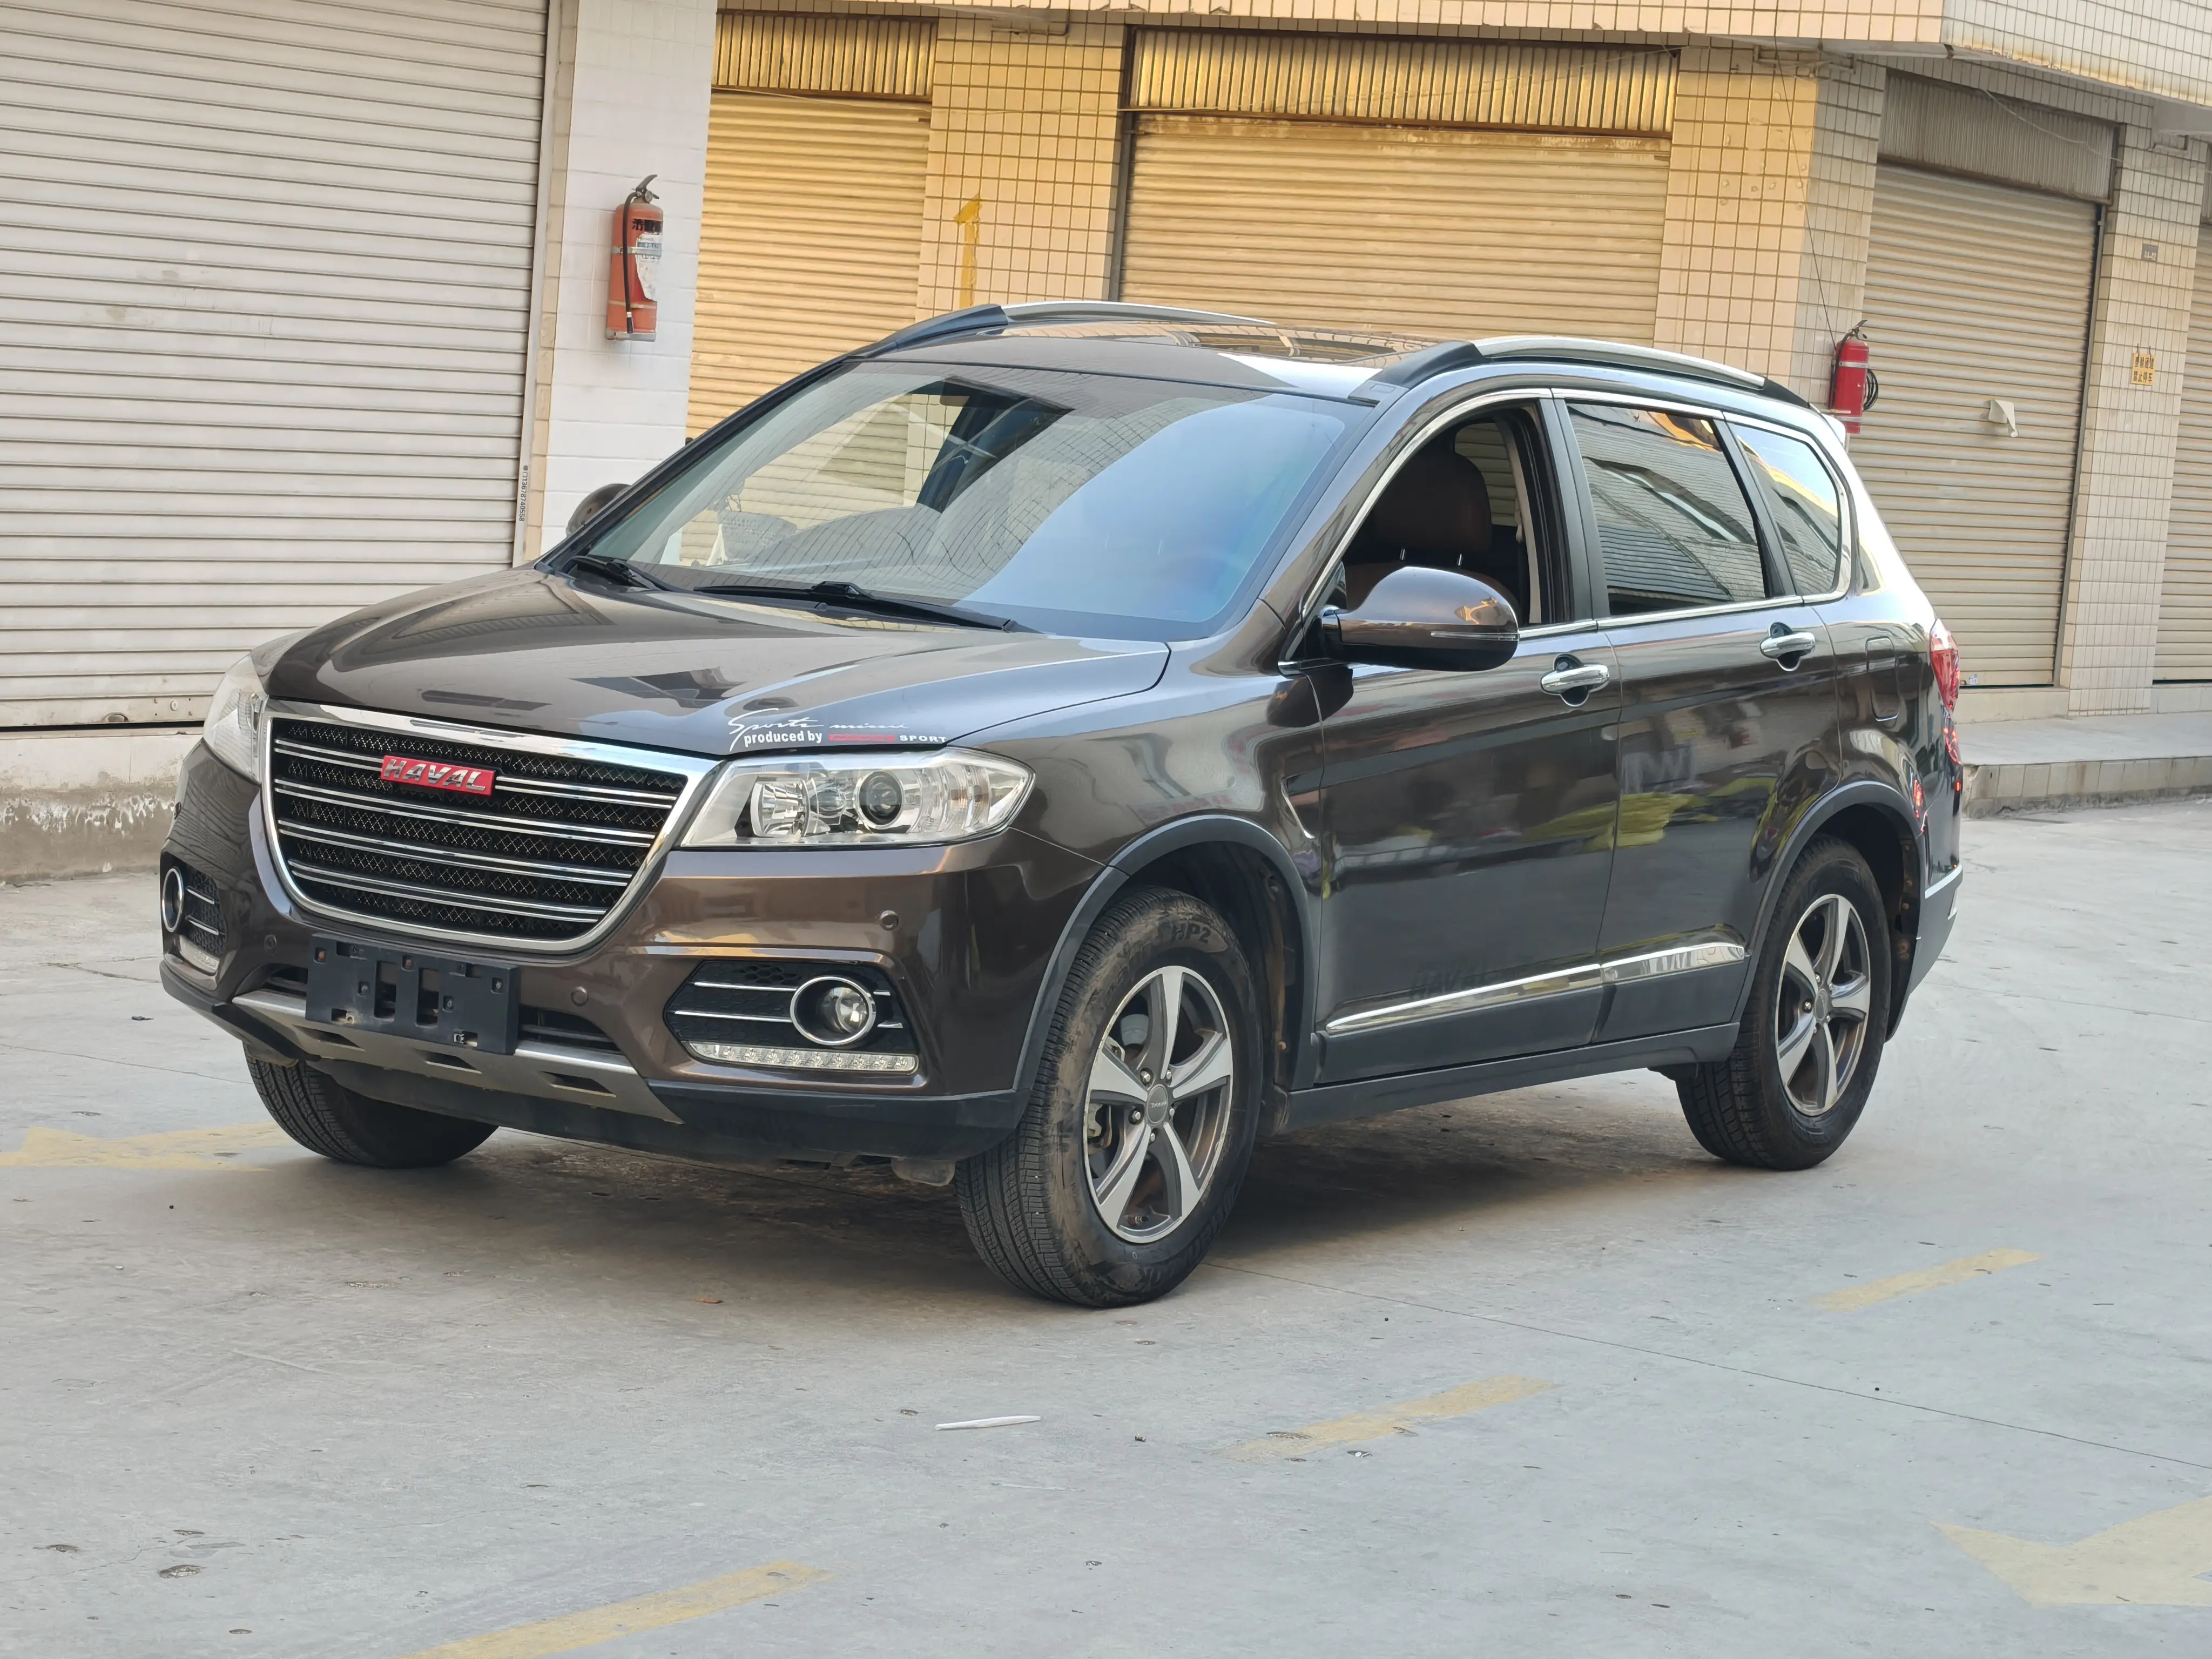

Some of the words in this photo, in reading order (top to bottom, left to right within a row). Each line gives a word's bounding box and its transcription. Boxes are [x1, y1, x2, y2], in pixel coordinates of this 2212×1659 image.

[744, 730, 805, 748] produced
[807, 731, 822, 744] by
[899, 734, 948, 744] SPORT
[383, 758, 486, 792] HAVAL
